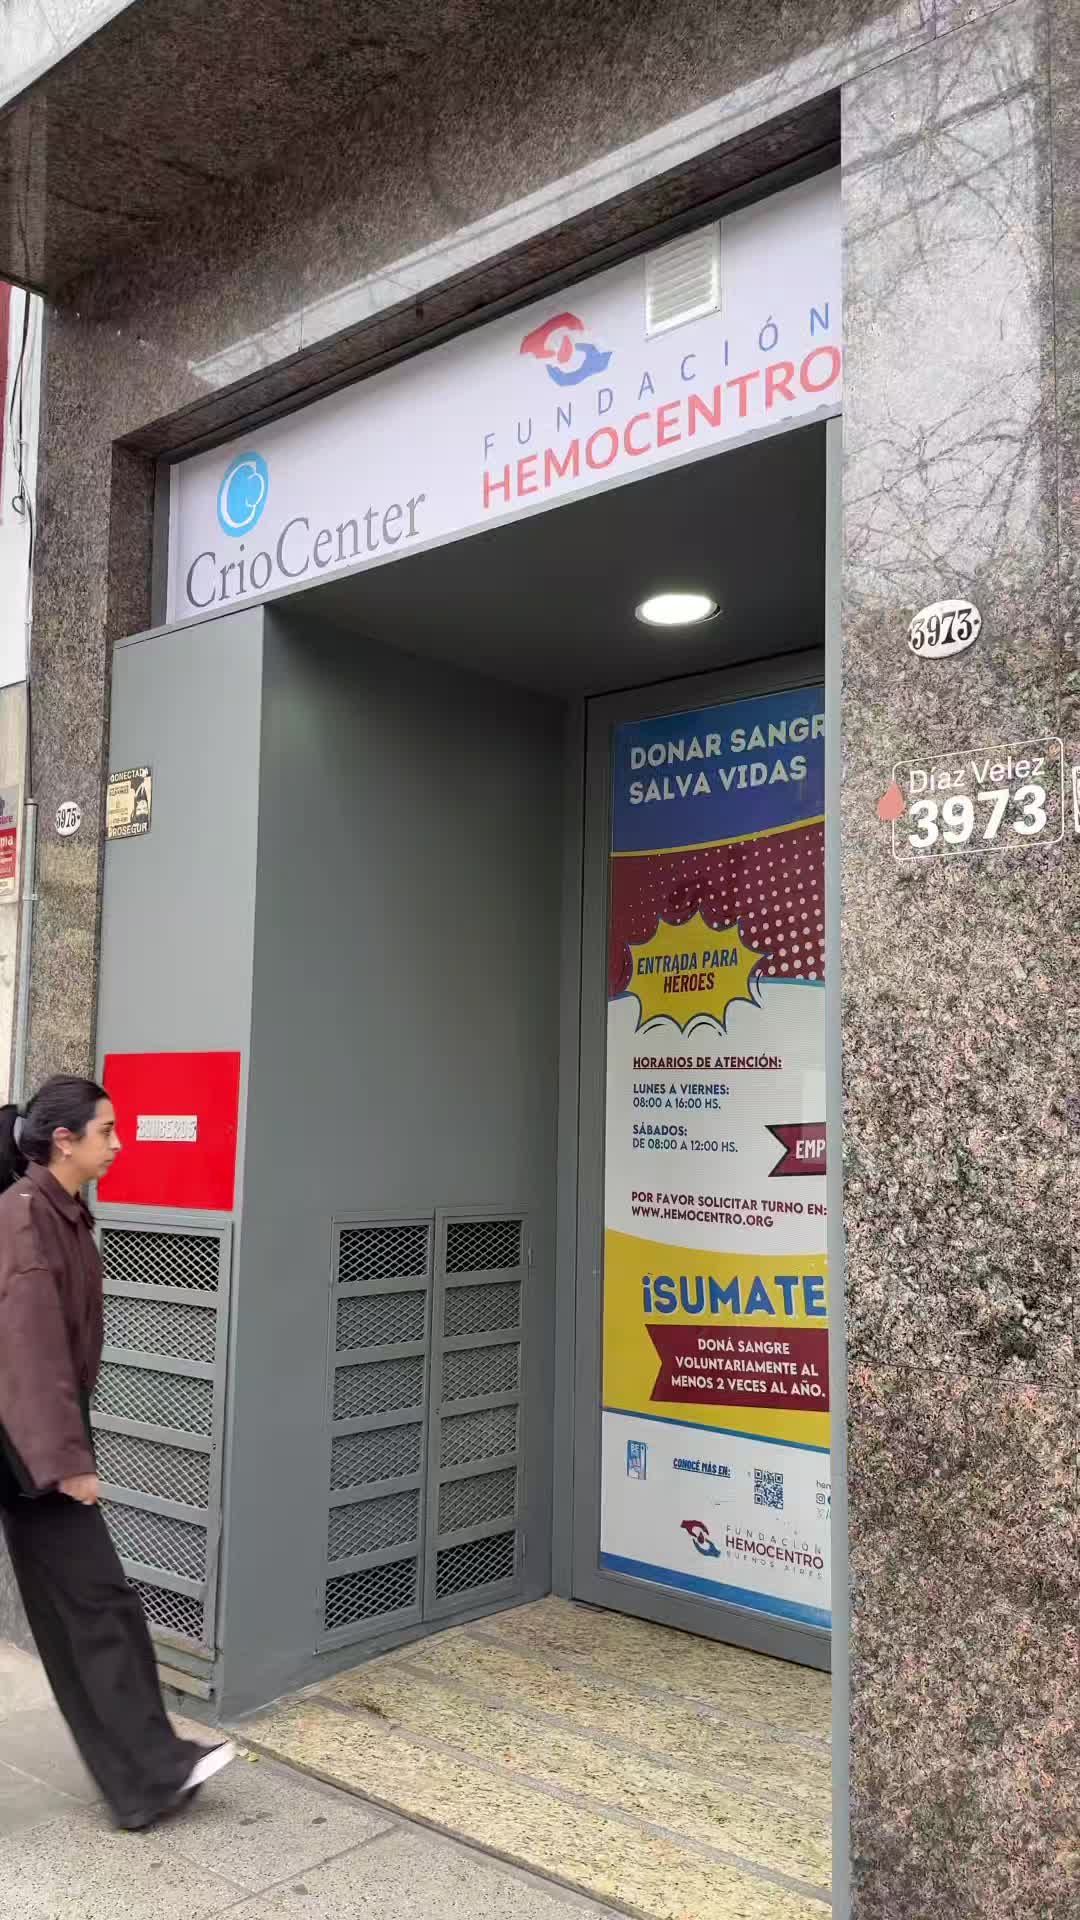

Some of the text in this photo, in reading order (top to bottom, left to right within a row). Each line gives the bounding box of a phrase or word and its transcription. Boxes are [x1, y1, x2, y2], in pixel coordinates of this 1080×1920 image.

[484, 302, 829, 461] FUNDACIÓN
[483, 345, 841, 509] HEMOCENTRO
[186, 493, 426, 608] CrioCenter
[911, 608, 973, 650] 3973
[630, 733, 722, 770] DONAR
[629, 755, 807, 805] SALVA VIDAS
[909, 756, 1046, 793] Díaz Velez
[908, 784, 1047, 848] 3973
[108, 822, 148, 838] PROSEGUR
[637, 947, 738, 975] ENTRADA PARA
[633, 1053, 783, 1069] HORARIOS DE ATENCIÓN:
[633, 1084, 730, 1095] LUNES A VIERNES:
[633, 1097, 721, 1109] 08:00 A 16:00 HS.
[632, 1121, 688, 1136] SÁBADOS:
[632, 1138, 738, 1152] DE 08:00 A 12:00 HS.
[631, 1191, 828, 1216] POR FAVOR SOLICITAR TURNO EN:
[631, 1206, 774, 1228] WWW.HEMOCENTRO.ORG
[698, 1337, 790, 1355] DONÁ SANGRE
[675, 1356, 819, 1377] VOLUNTARIAMENTE AL
[671, 1375, 826, 1397] MENOS 2 VECES AL AÑO.
[725, 1535, 824, 1570] HEMOCENTRO
